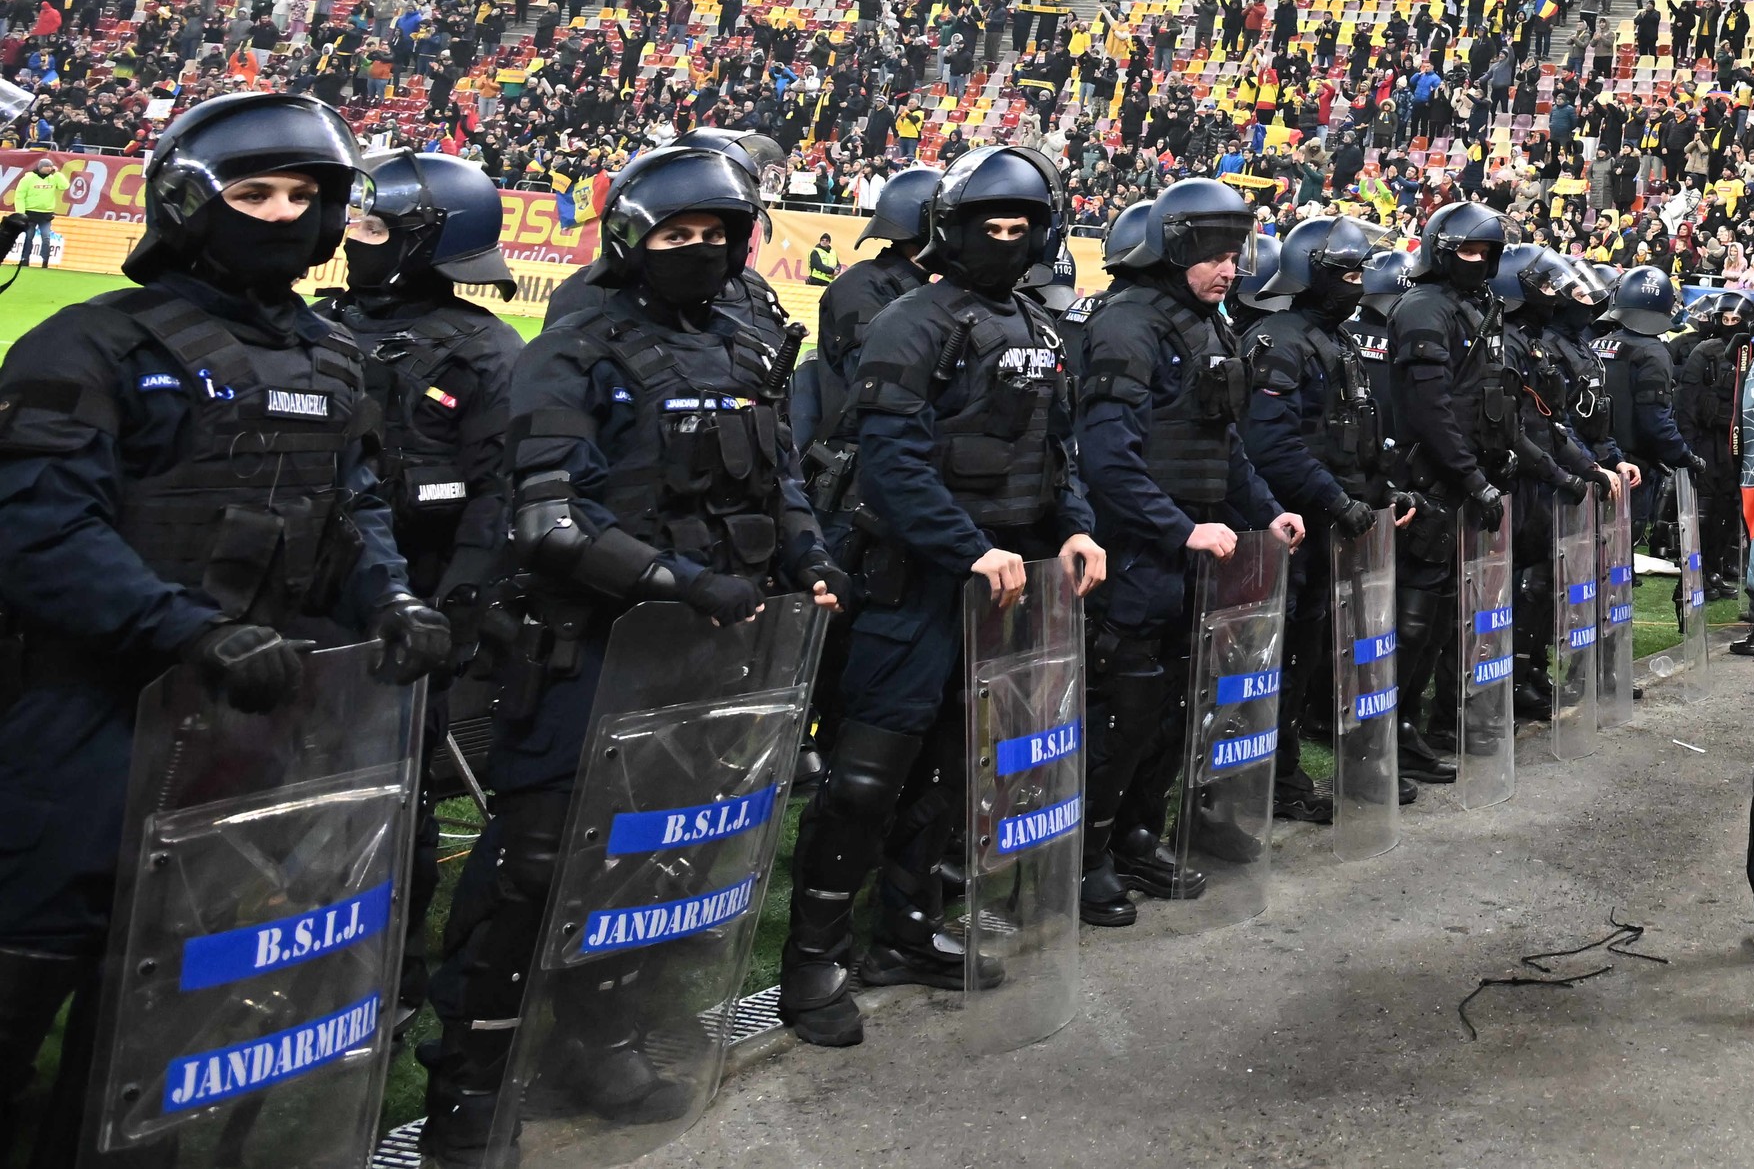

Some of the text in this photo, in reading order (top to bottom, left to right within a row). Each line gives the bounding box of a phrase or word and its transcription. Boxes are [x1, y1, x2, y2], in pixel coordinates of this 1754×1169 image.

[1053, 264, 1073, 276] 1102
[1741, 344, 1749, 372] Canon
[267, 389, 329, 417] JANDARMERIA
[418, 482, 467, 502] JANDARMERIA
[1031, 726, 1076, 764] B.S.I.J.
[661, 800, 751, 845] B.S.I.J.
[588, 880, 753, 948] JANDARMERIA
[253, 900, 365, 969] B.S.I.J.
[170, 996, 378, 1106] JANDARMERIA
